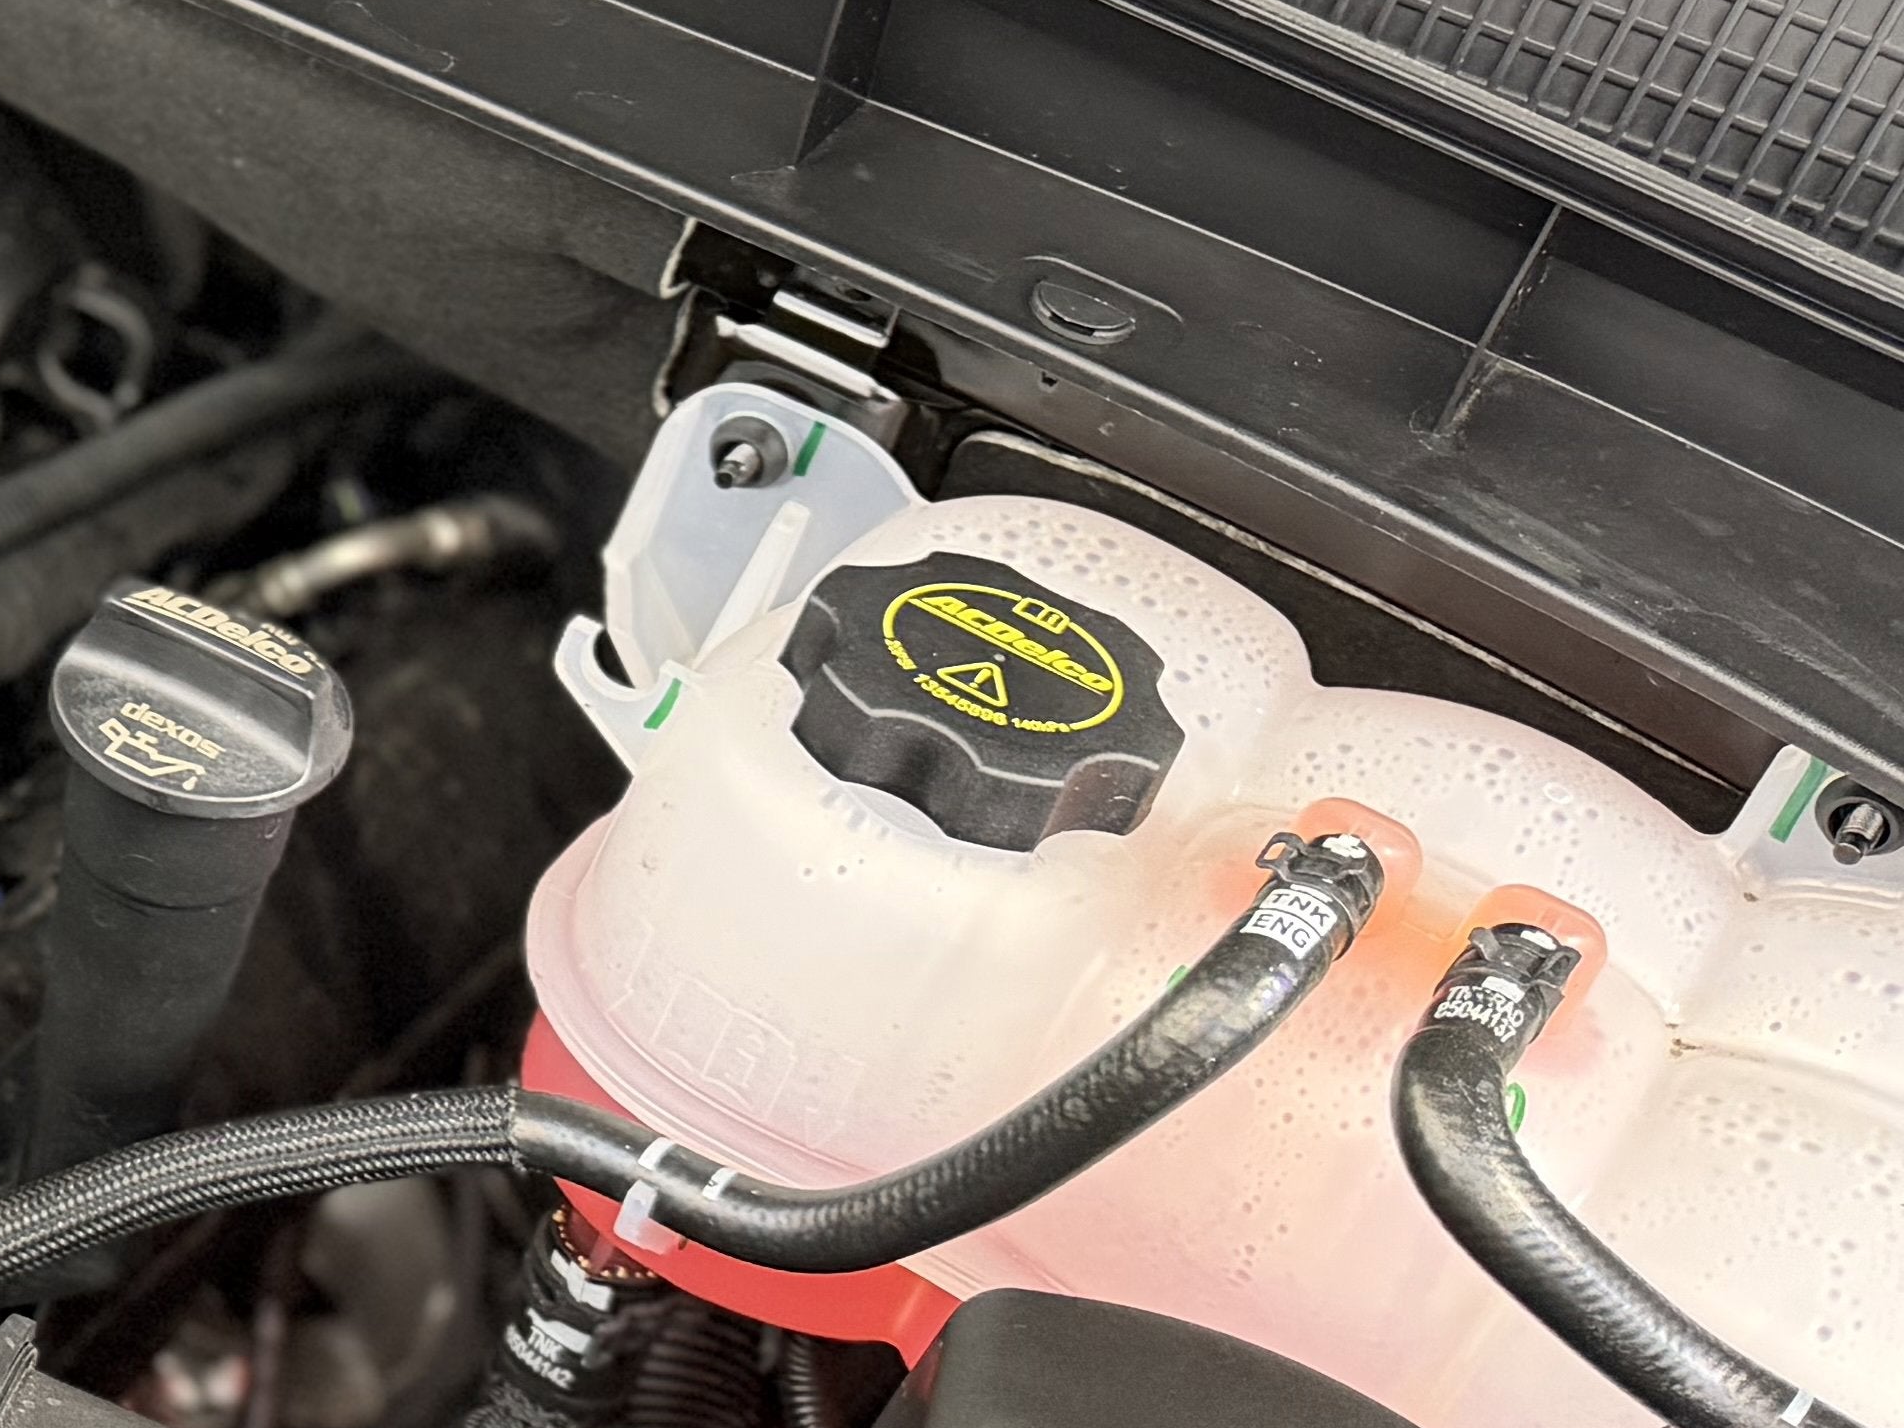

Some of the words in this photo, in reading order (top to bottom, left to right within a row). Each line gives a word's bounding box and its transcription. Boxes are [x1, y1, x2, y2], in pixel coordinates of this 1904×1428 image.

[129, 587, 313, 675] ACDelco
[919, 595, 1113, 692] ACDelco
[120, 701, 226, 760] dexos
[1252, 911, 1310, 949] ENG
[1272, 890, 1329, 926] TNK
[527, 1324, 564, 1362] TNK
